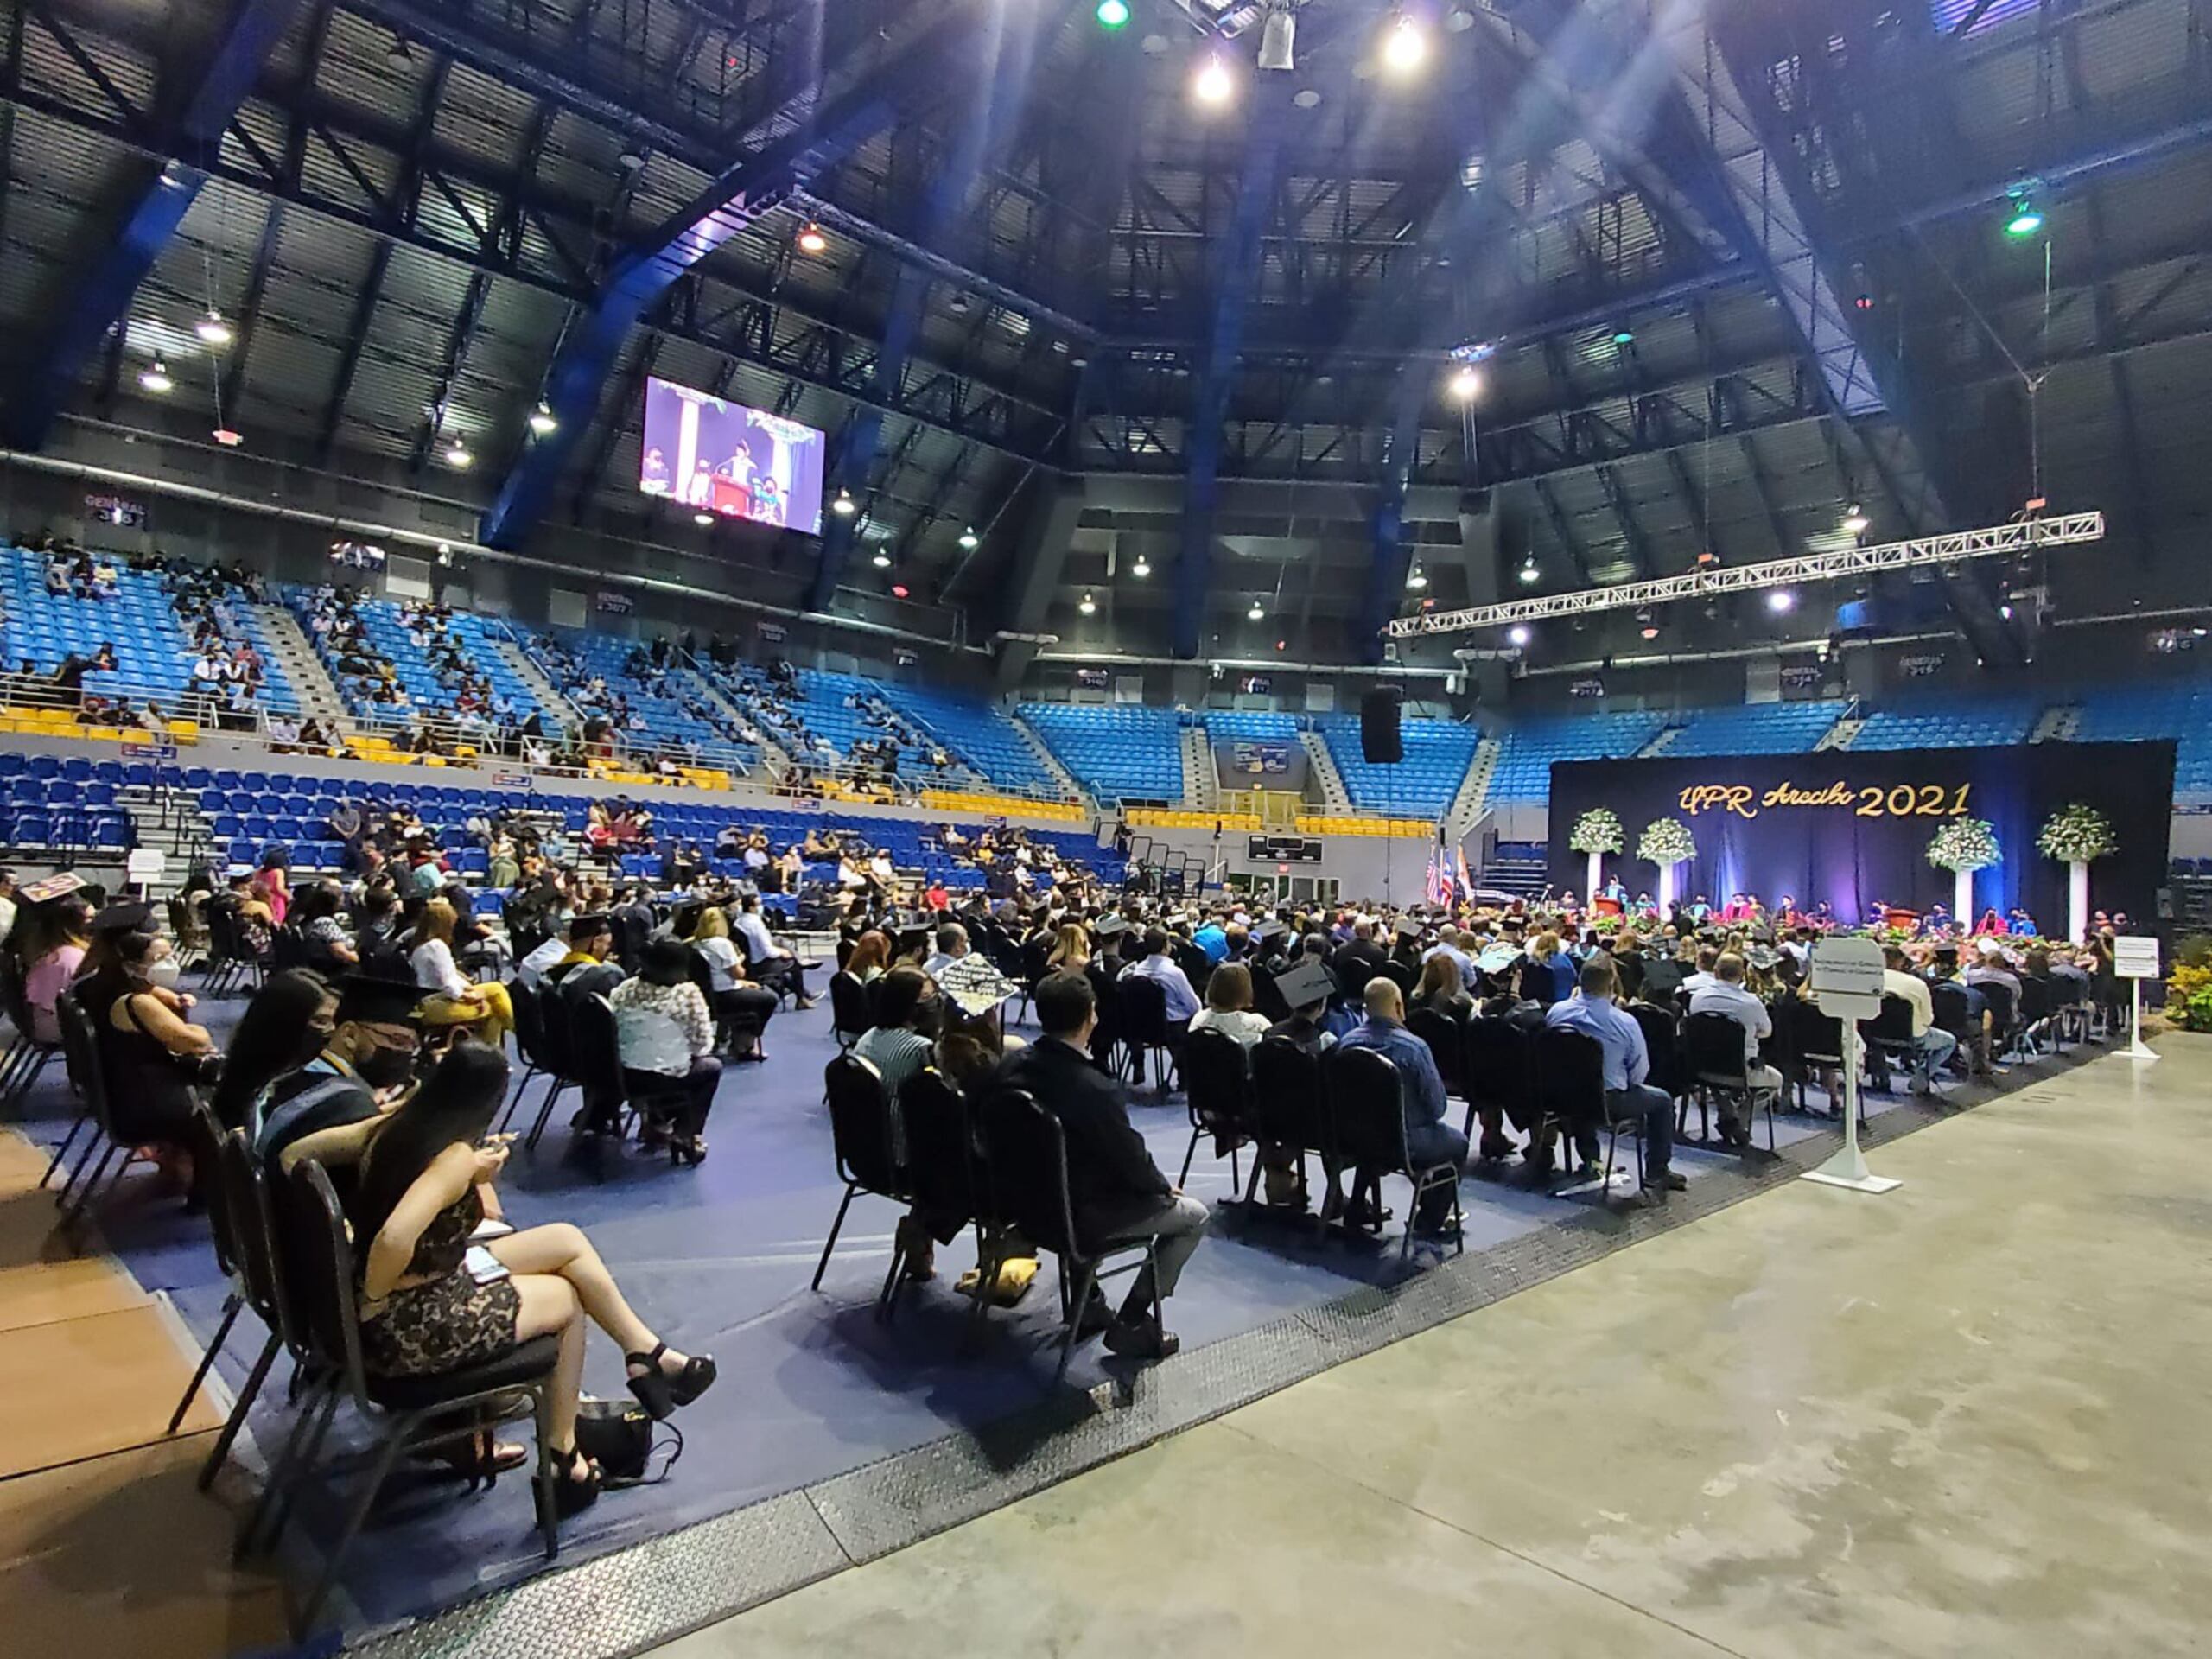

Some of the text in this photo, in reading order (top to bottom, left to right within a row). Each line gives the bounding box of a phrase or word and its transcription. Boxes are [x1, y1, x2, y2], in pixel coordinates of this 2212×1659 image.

[84, 494, 146, 516] GENERAL
[1678, 781, 1971, 819] UPR Arecibo 2021
